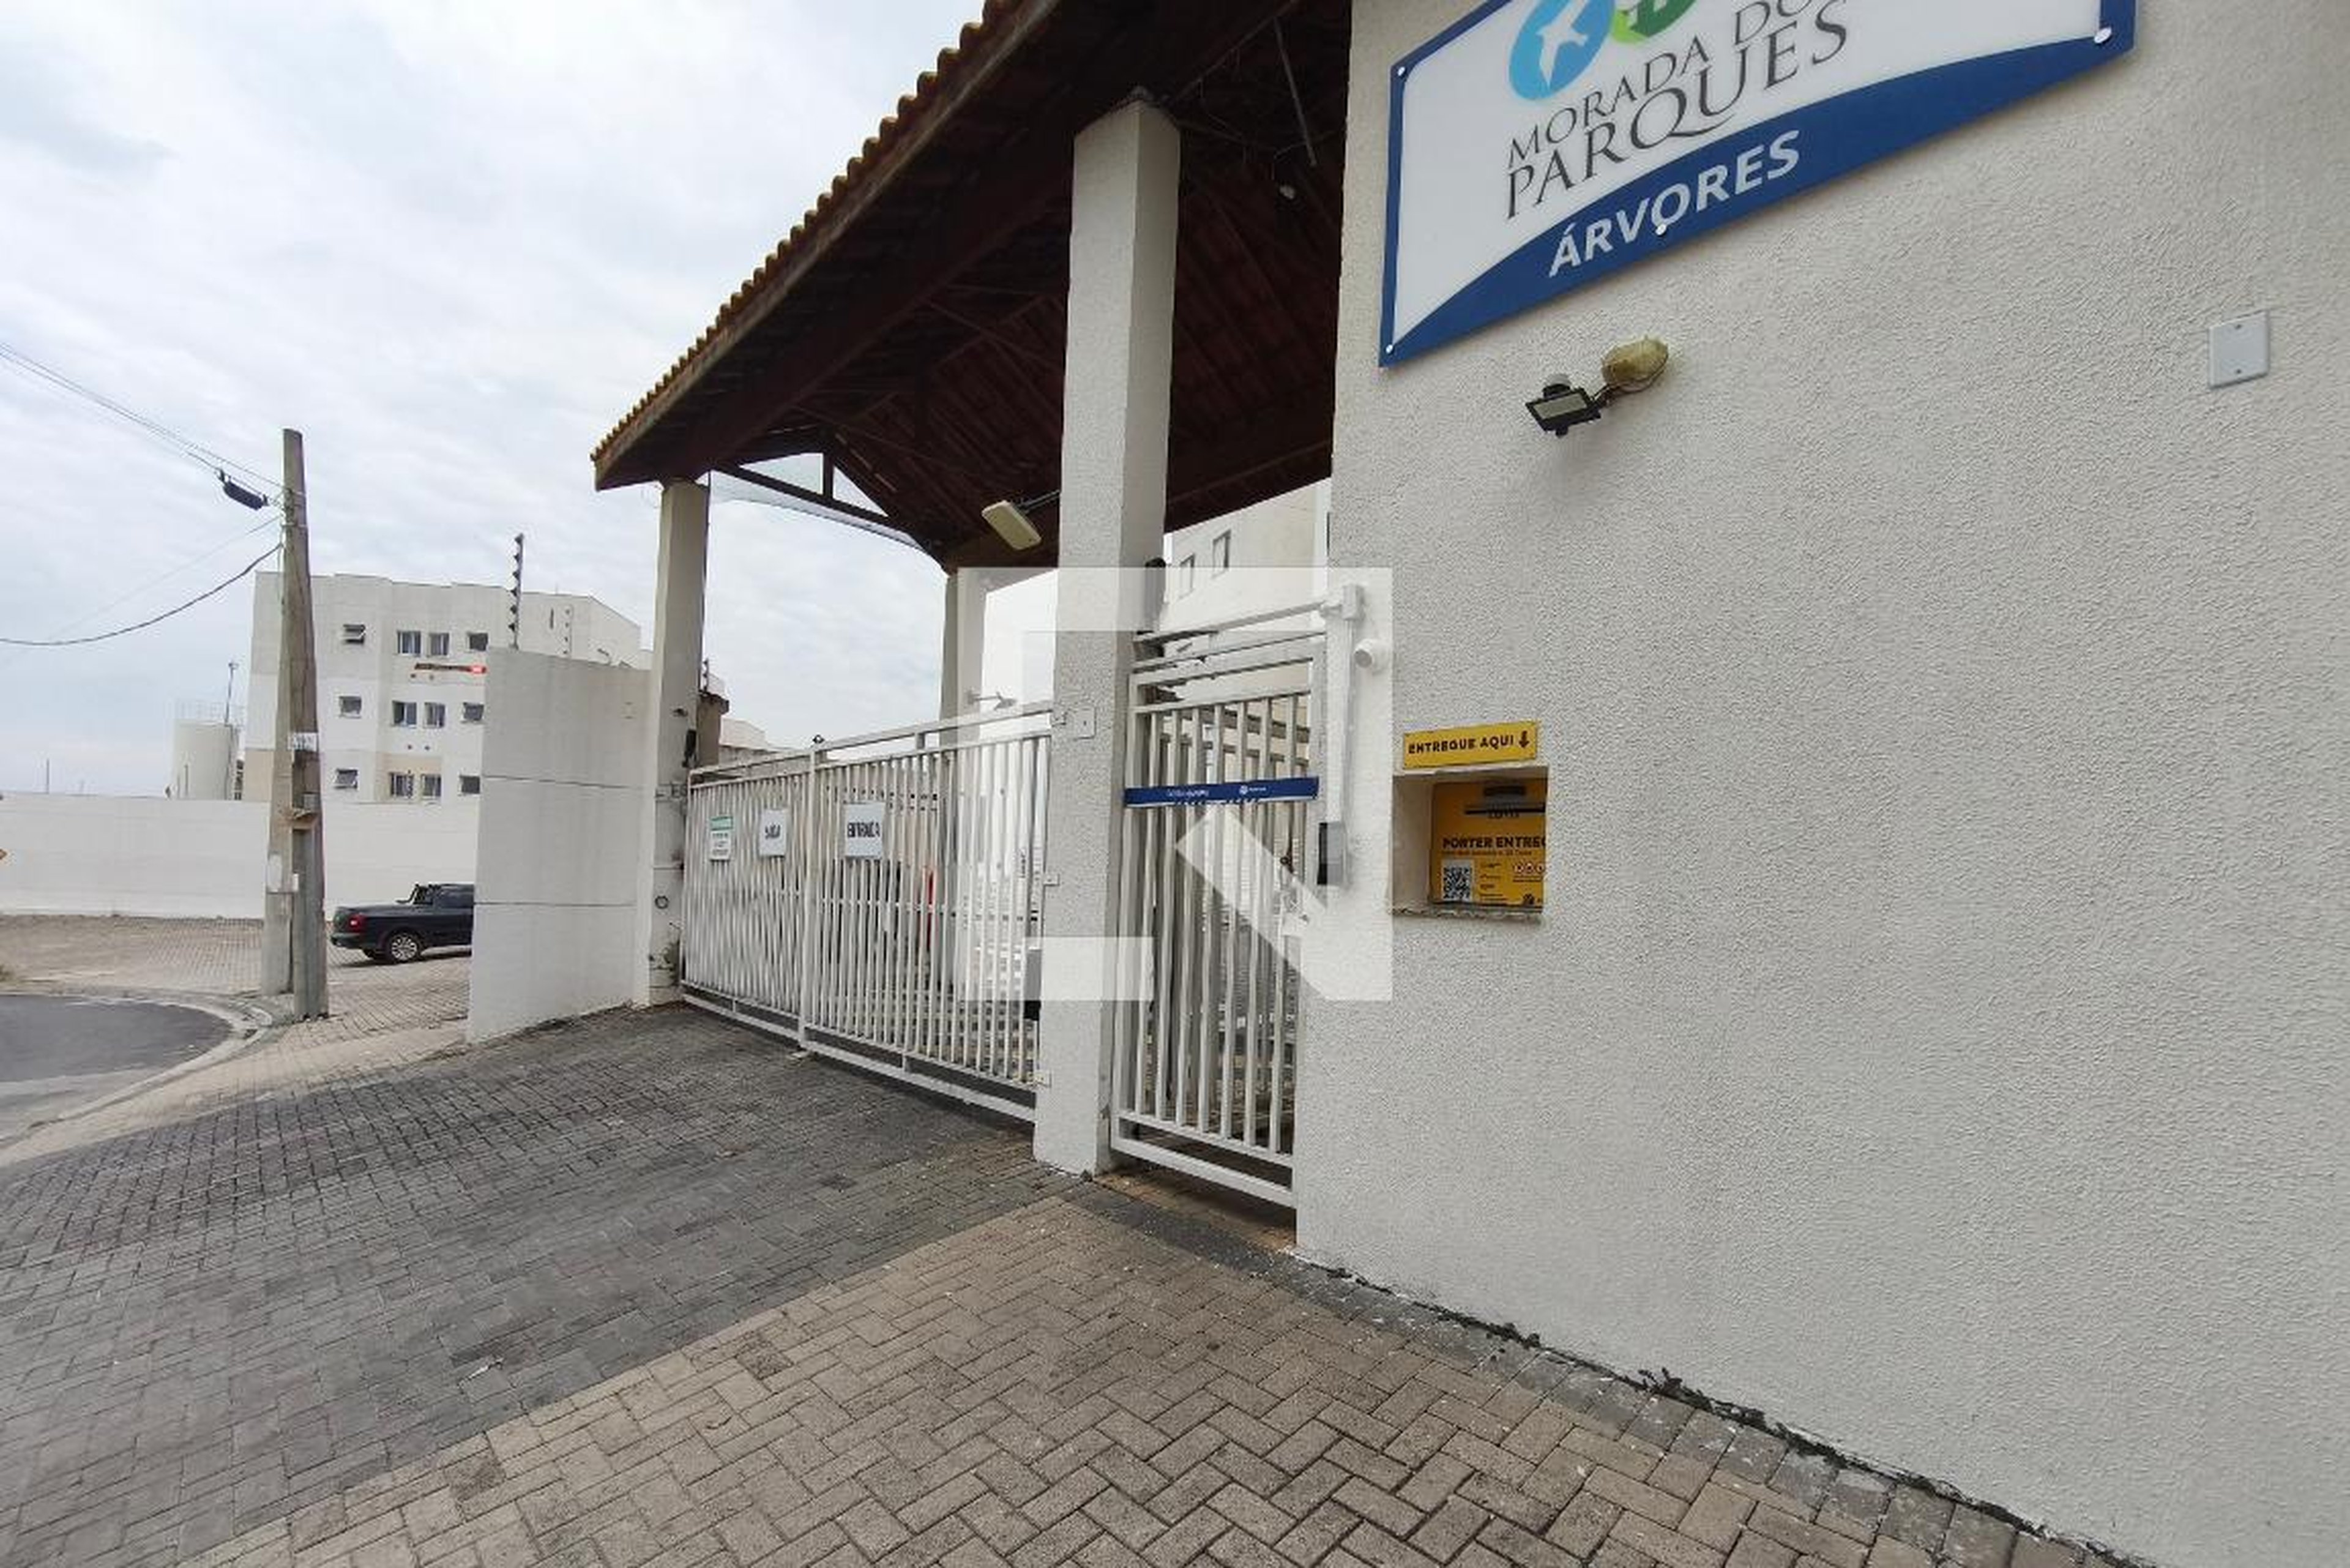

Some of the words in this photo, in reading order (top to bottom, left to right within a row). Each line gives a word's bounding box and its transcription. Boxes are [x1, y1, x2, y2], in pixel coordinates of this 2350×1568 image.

[1507, 0, 1847, 220] PARQUES
[1508, 35, 1710, 169] MORADA
[1549, 129, 1800, 278] ÁRVORES
[1408, 739, 1475, 754] ENTREGUE
[1480, 734, 1514, 750] AQUI
[1442, 837, 1493, 848] PORTER
